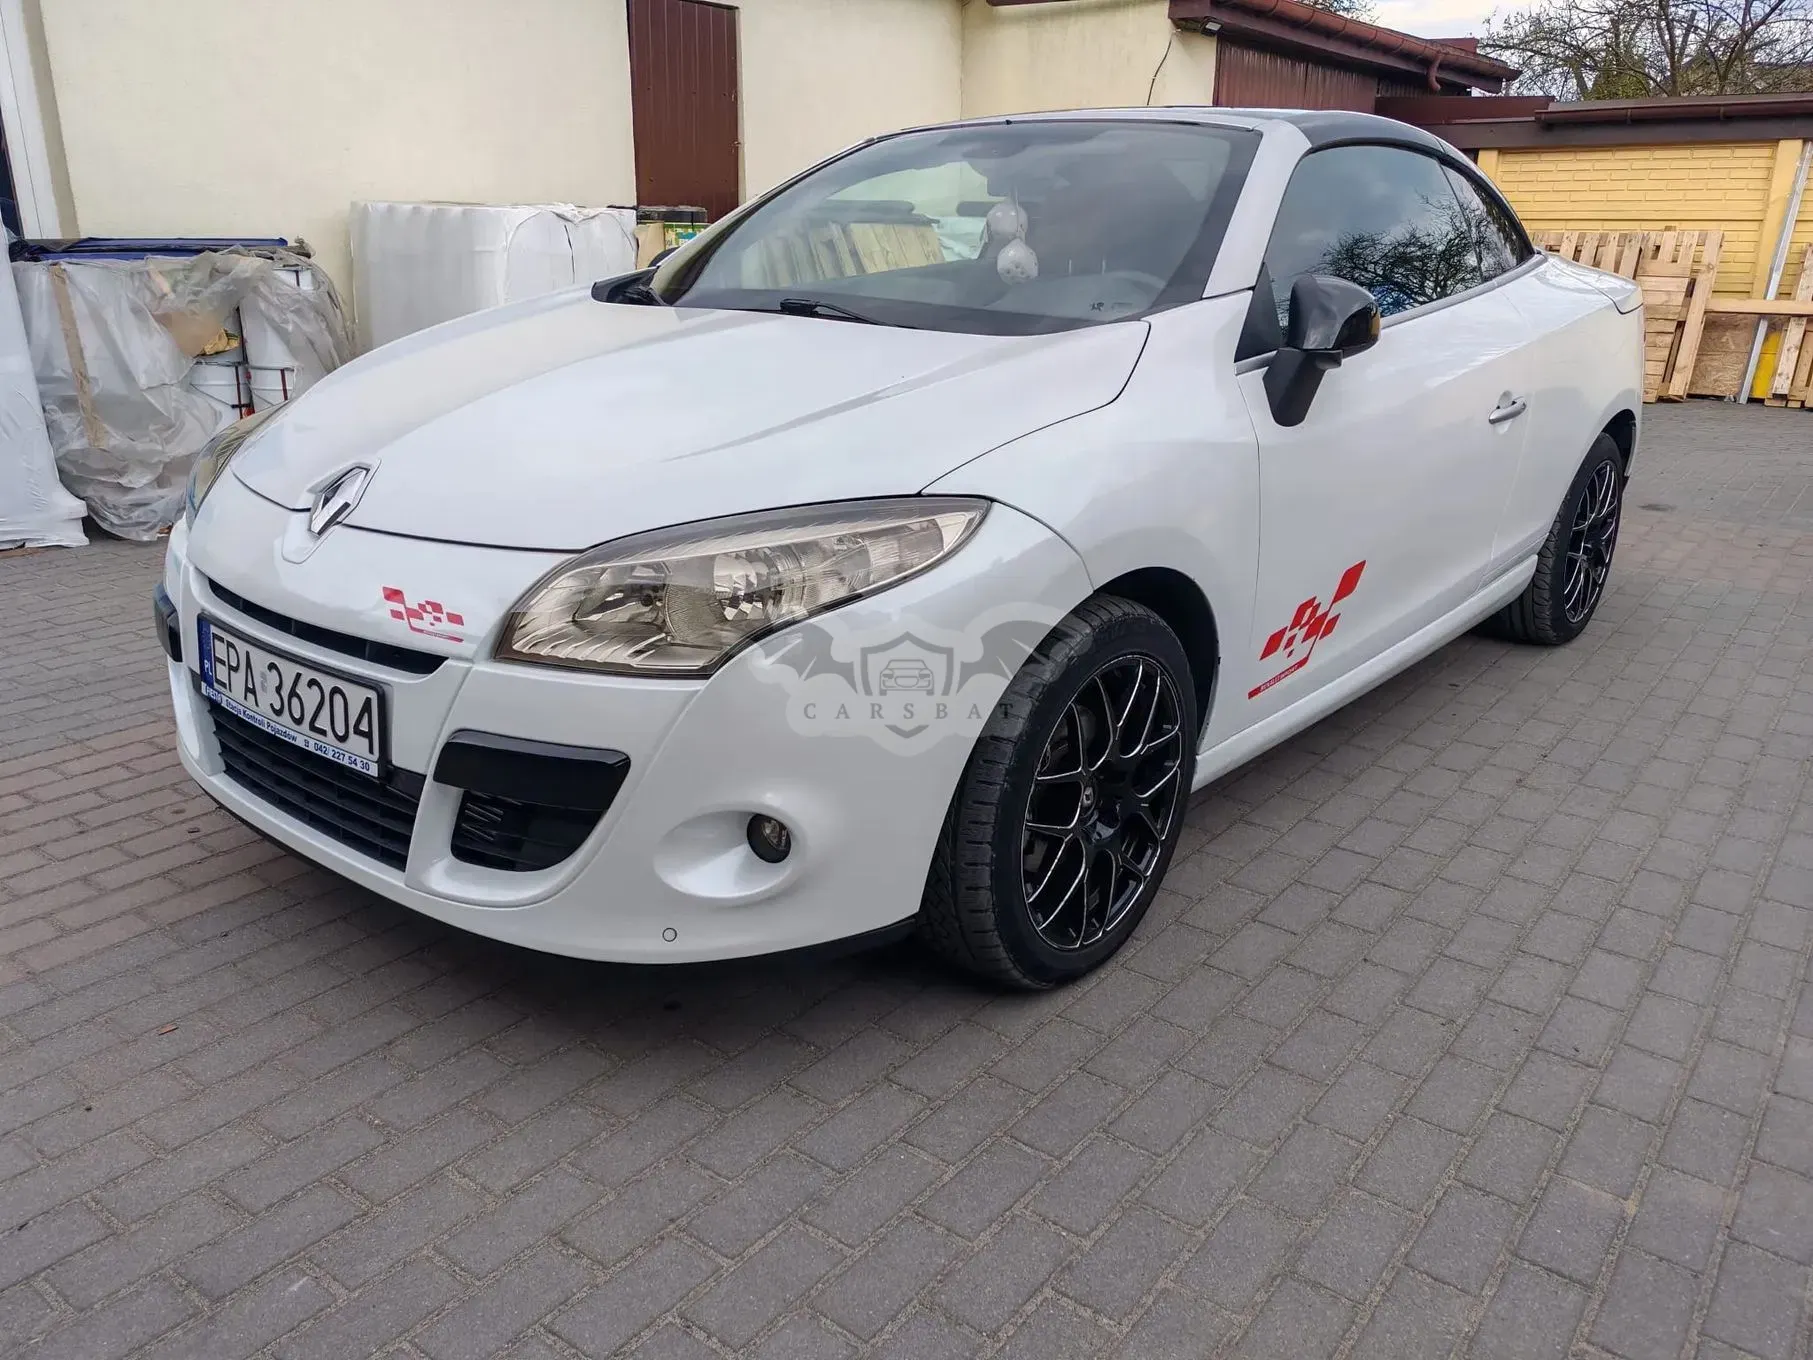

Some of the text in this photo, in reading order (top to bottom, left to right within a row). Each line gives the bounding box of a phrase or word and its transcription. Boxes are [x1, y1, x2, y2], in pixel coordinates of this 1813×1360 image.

[204, 660, 213, 676] PL
[212, 632, 374, 755] EPA 36204
[331, 749, 346, 762] 227
[348, 755, 358, 767] 54
[360, 760, 370, 772] 30
